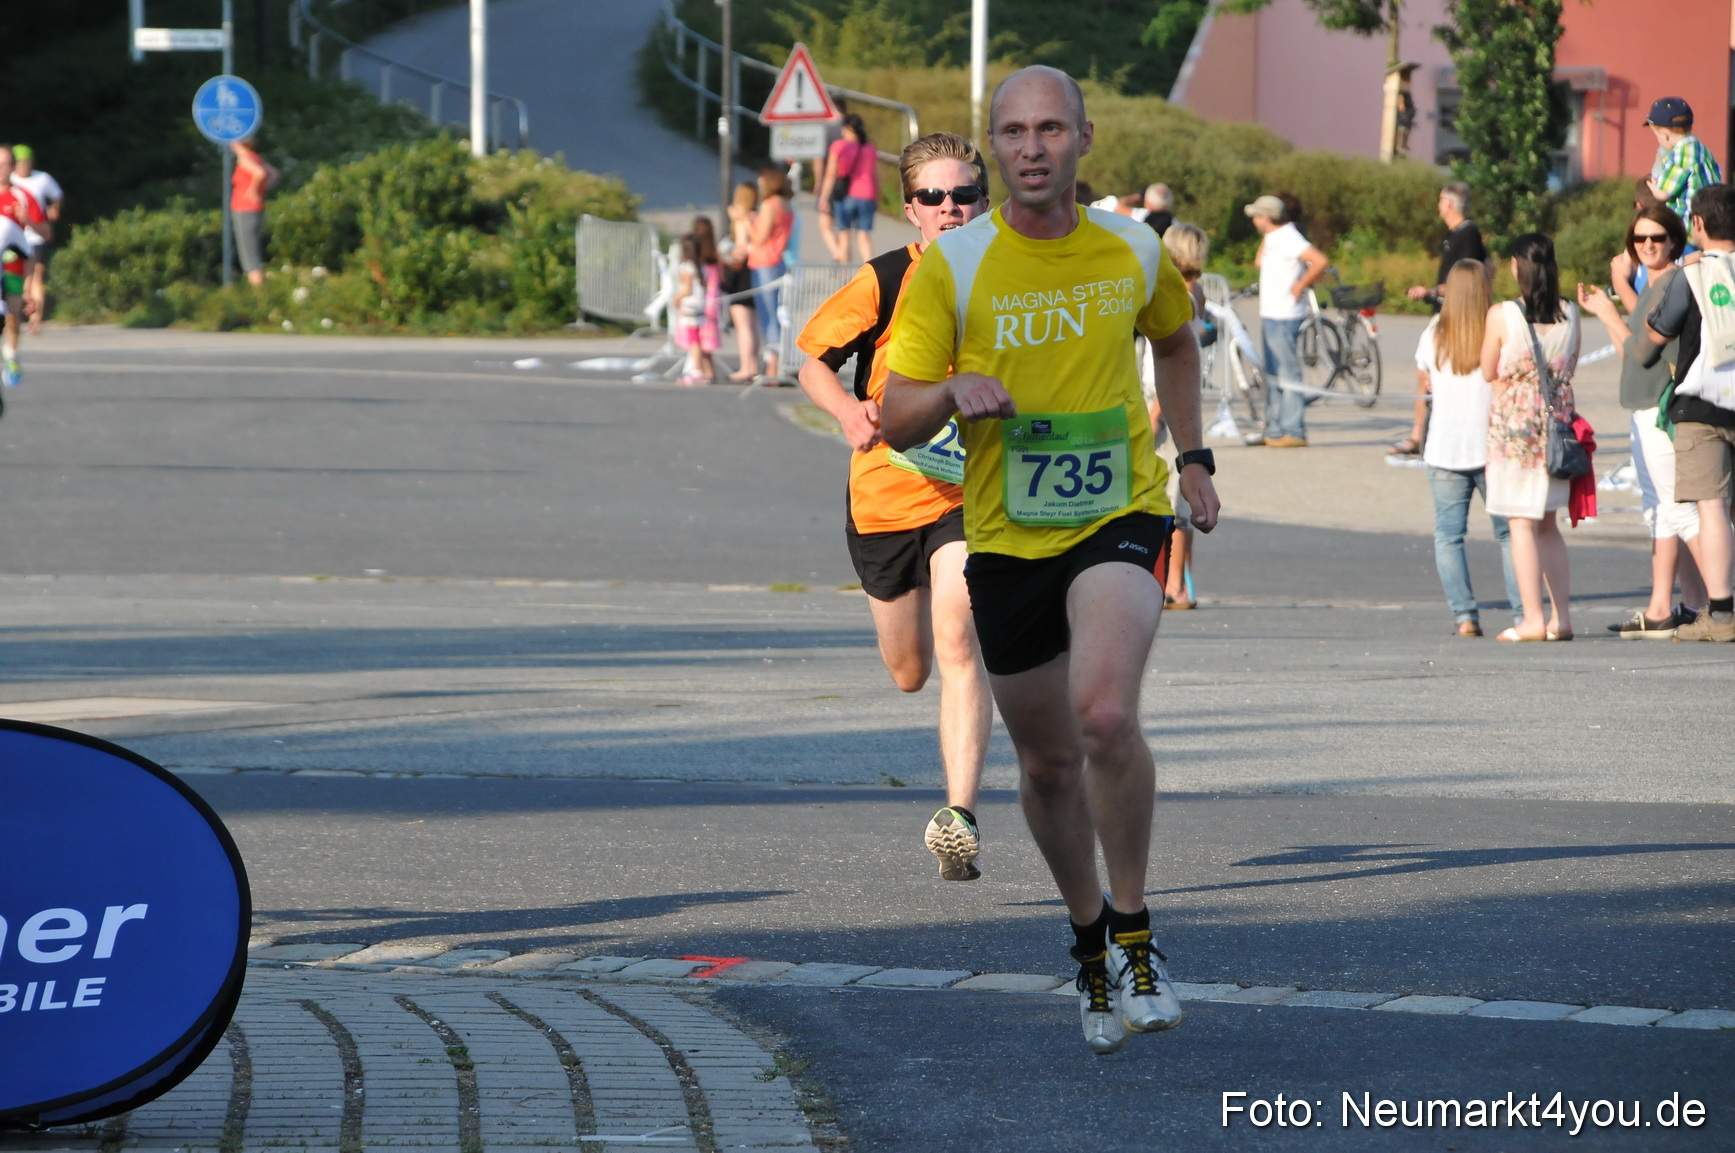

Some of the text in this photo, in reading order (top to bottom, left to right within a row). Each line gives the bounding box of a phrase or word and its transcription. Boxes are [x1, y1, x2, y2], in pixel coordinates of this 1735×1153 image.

[991, 277, 1134, 312] MAGNA STEYR
[1097, 297, 1133, 316] 2014
[993, 302, 1088, 350] RUN
[917, 452, 961, 469] Christoph Sturm
[1022, 450, 1113, 498] 735
[1016, 510, 1038, 518] Magna
[1039, 510, 1057, 518] Steyr
[1073, 508, 1100, 518] Systems
[1100, 504, 1120, 513] GmbH
[1043, 499, 1095, 508] Jakum Dietmar
[1129, 542, 1148, 554] asics
[0, 903, 148, 964] er
